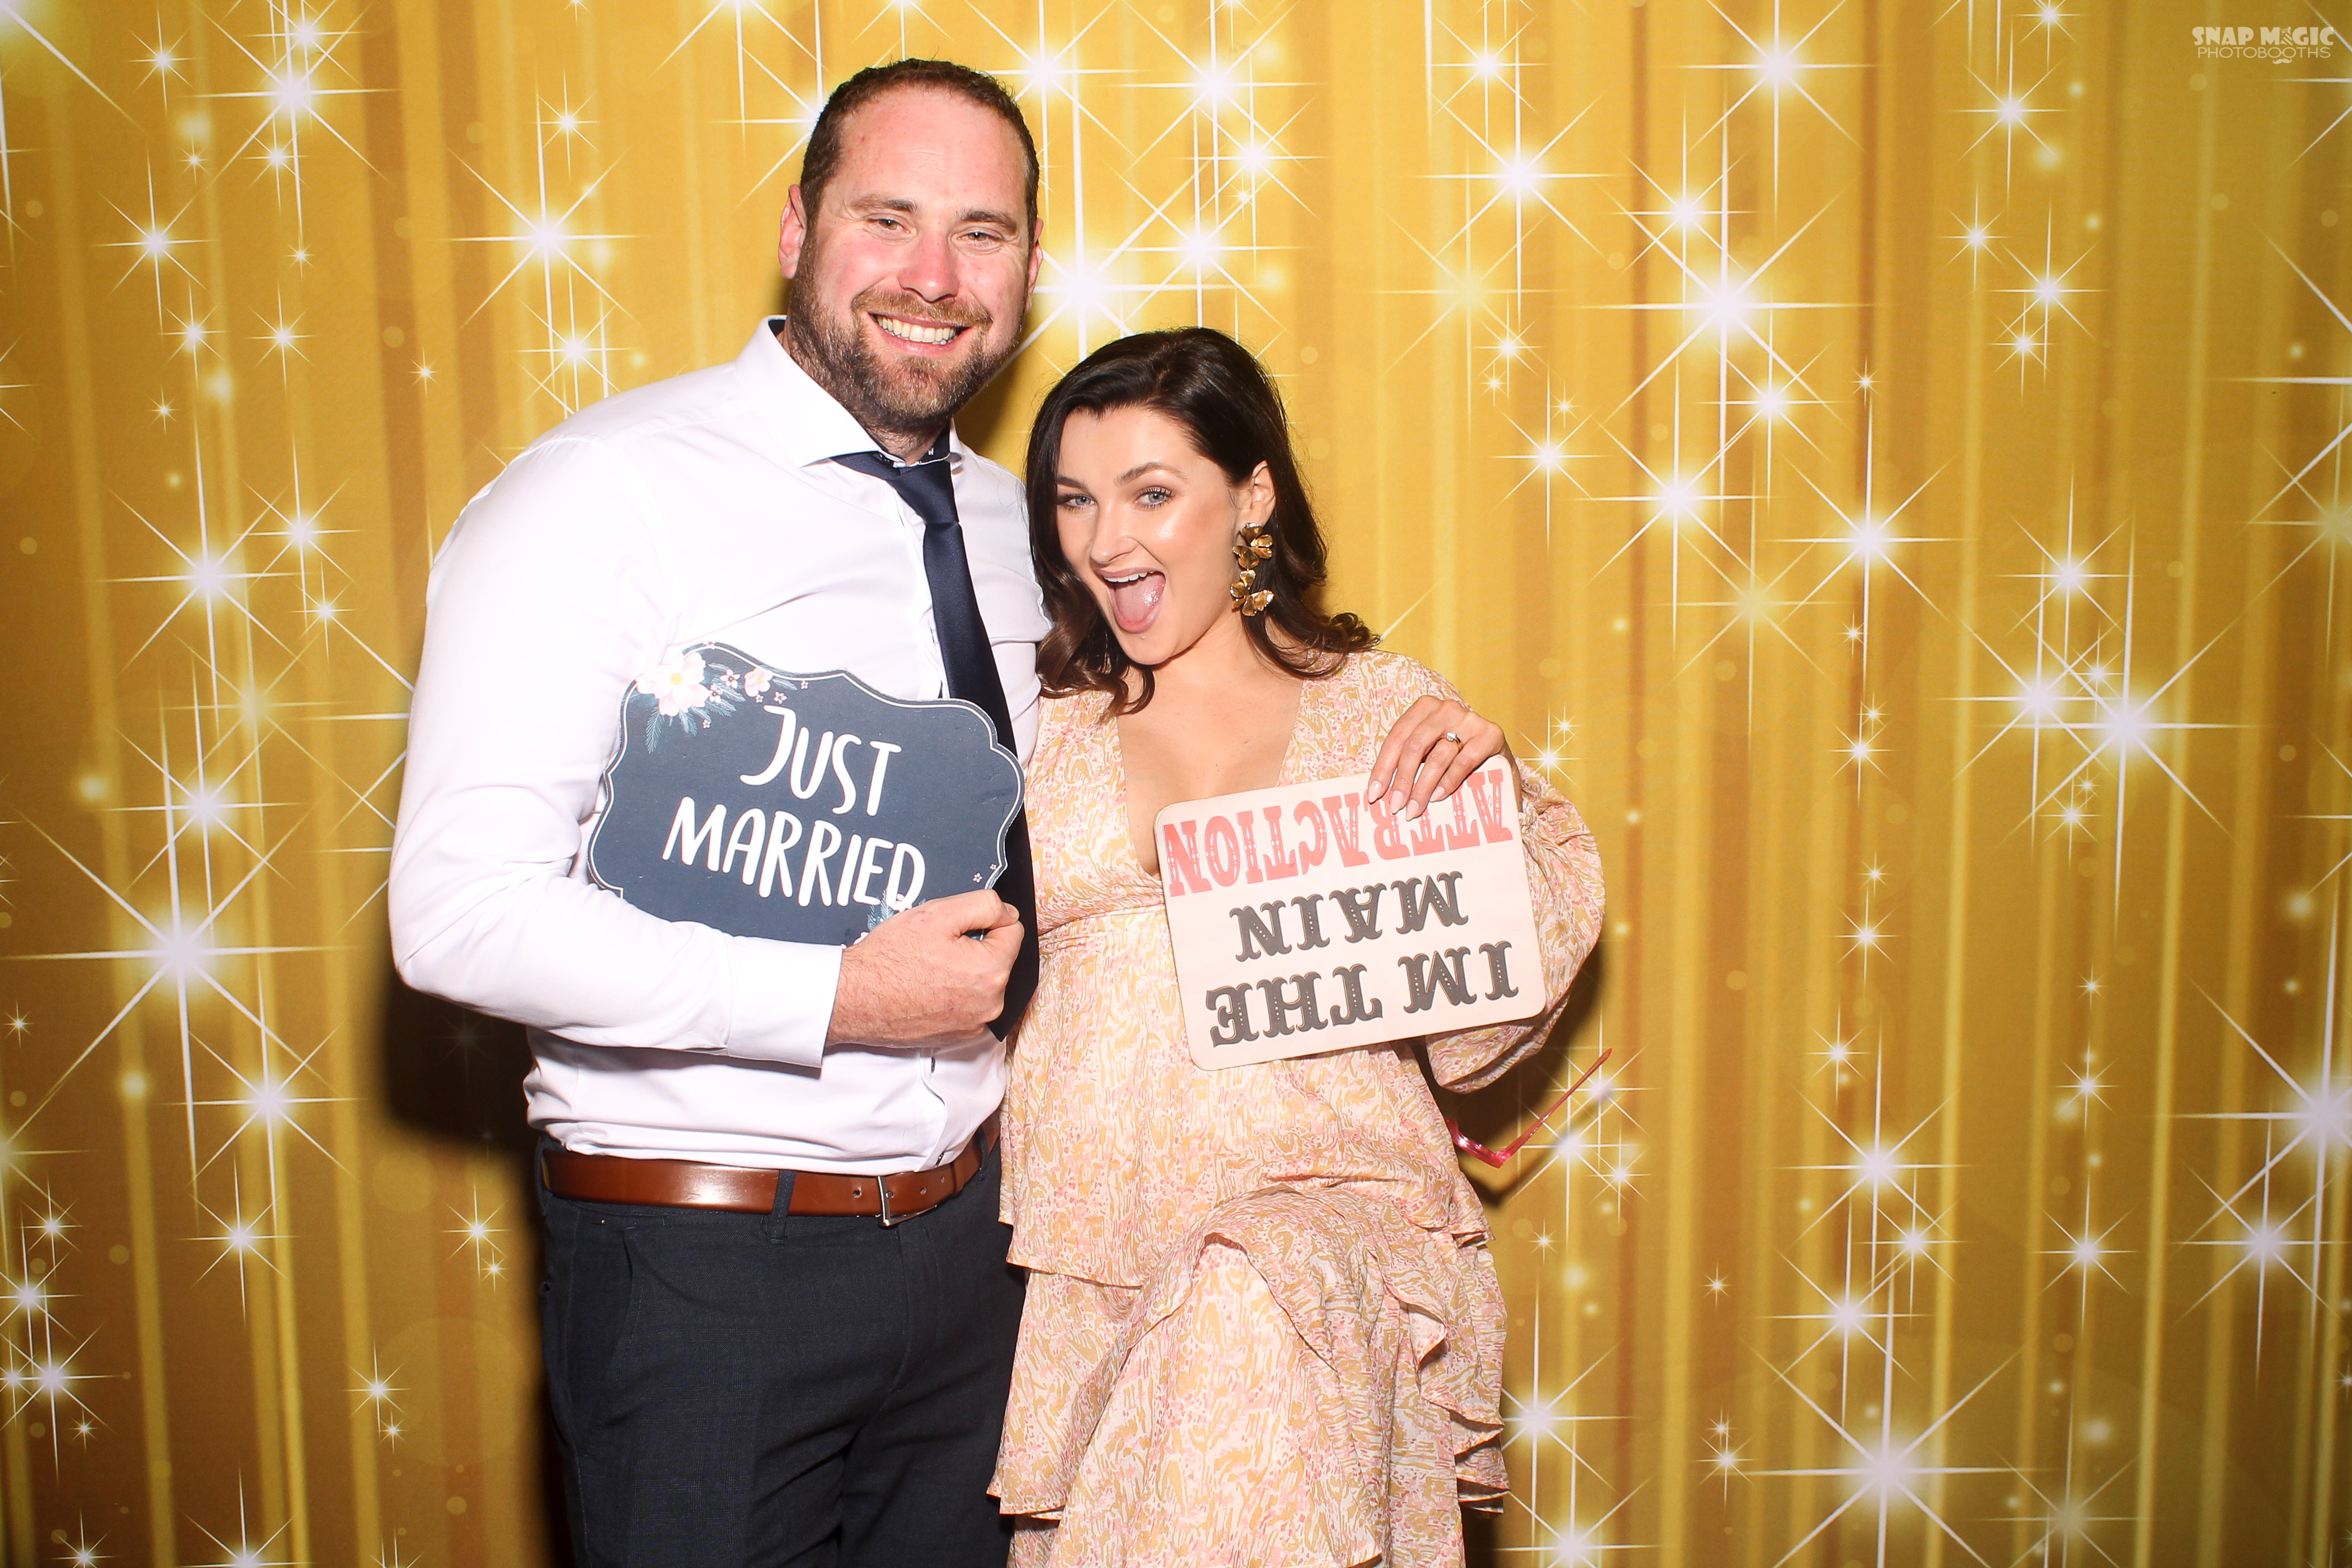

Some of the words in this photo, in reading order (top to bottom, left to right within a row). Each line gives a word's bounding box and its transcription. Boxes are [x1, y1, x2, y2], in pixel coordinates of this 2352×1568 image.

[740, 705, 902, 817] JUST
[662, 797, 926, 908] MARRIED
[1163, 768, 1513, 897] ATTRACTION
[1230, 871, 1469, 962] MAIN
[1205, 963, 1383, 1048] THE
[1398, 941, 1519, 1014] IM
